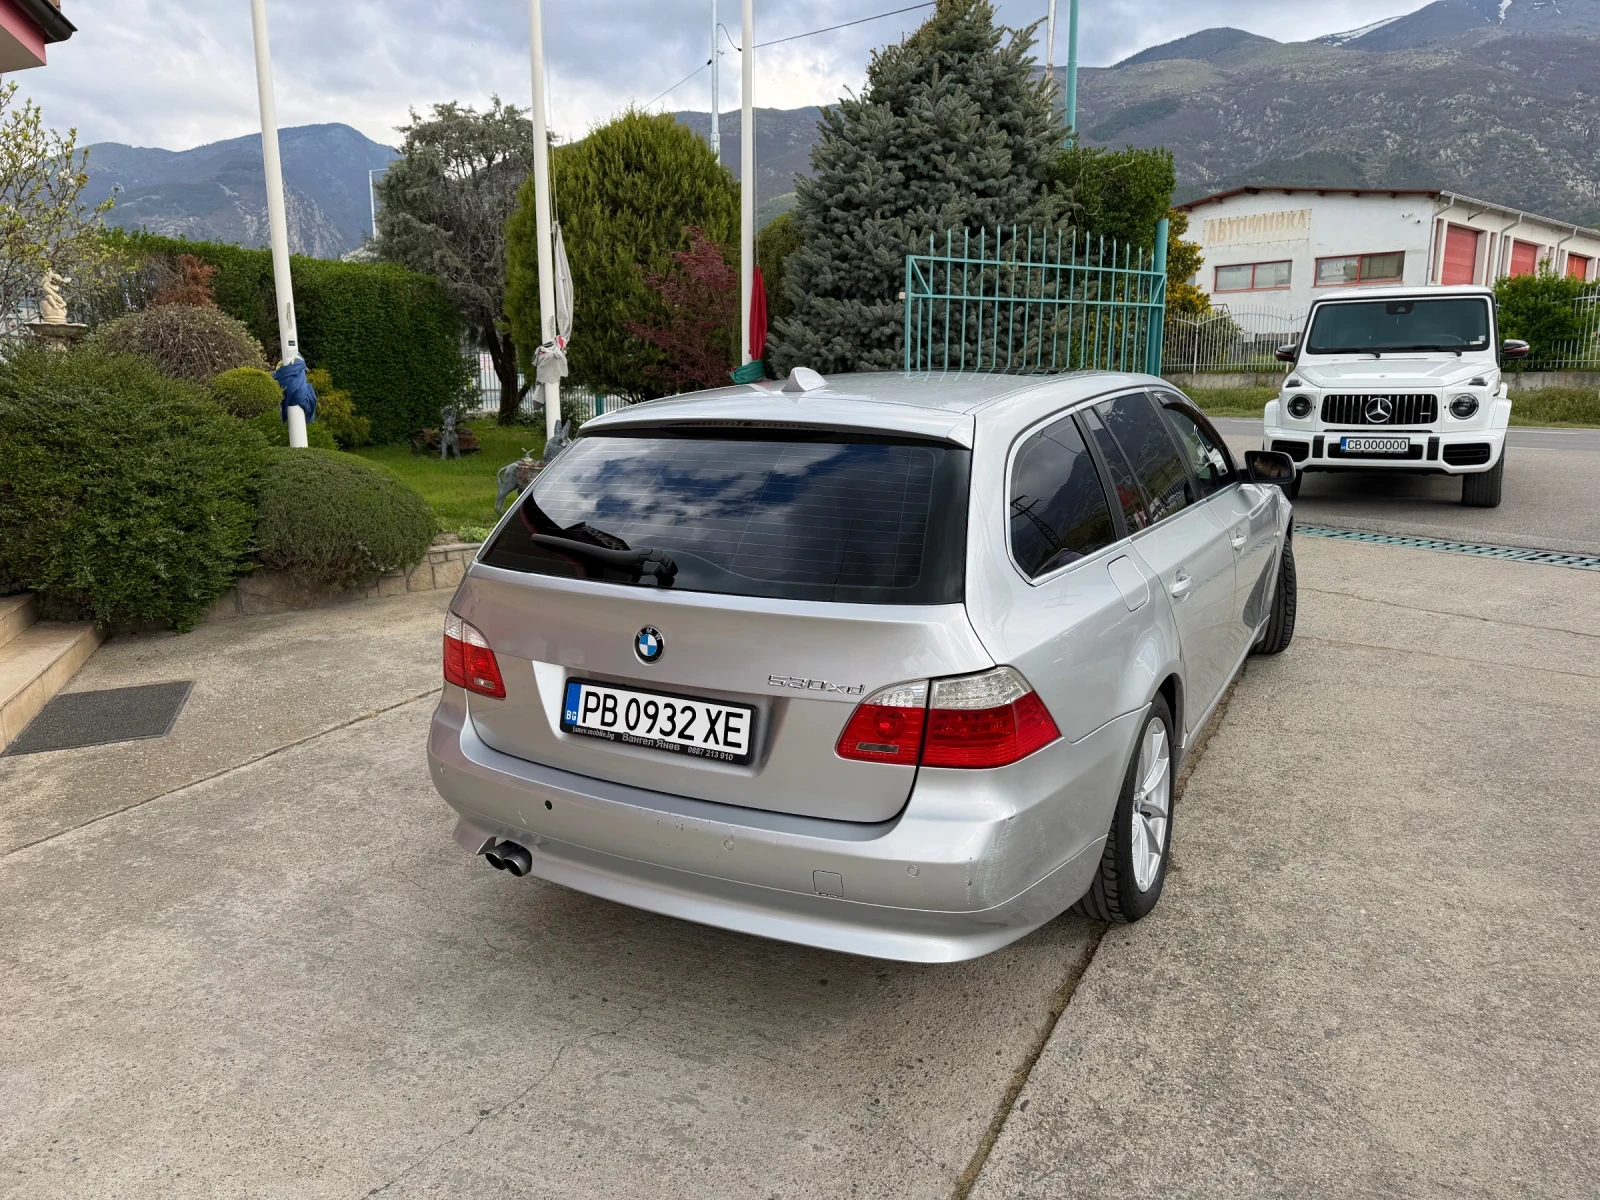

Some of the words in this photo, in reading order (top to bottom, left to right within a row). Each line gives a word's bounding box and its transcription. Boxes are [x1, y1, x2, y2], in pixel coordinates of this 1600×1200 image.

[1207, 211, 1307, 246] АВТОМИВКА
[1347, 440, 1362, 450] CB
[1364, 440, 1407, 450] 000000
[637, 627, 662, 641] BMW
[768, 674, 866, 695] 530xd
[566, 710, 577, 721] BG
[582, 691, 618, 727] PB
[625, 698, 697, 741] 0932
[702, 708, 744, 749] XE
[622, 732, 654, 747] Вангел
[655, 739, 680, 751] Янев
[720, 752, 734, 761] 910
